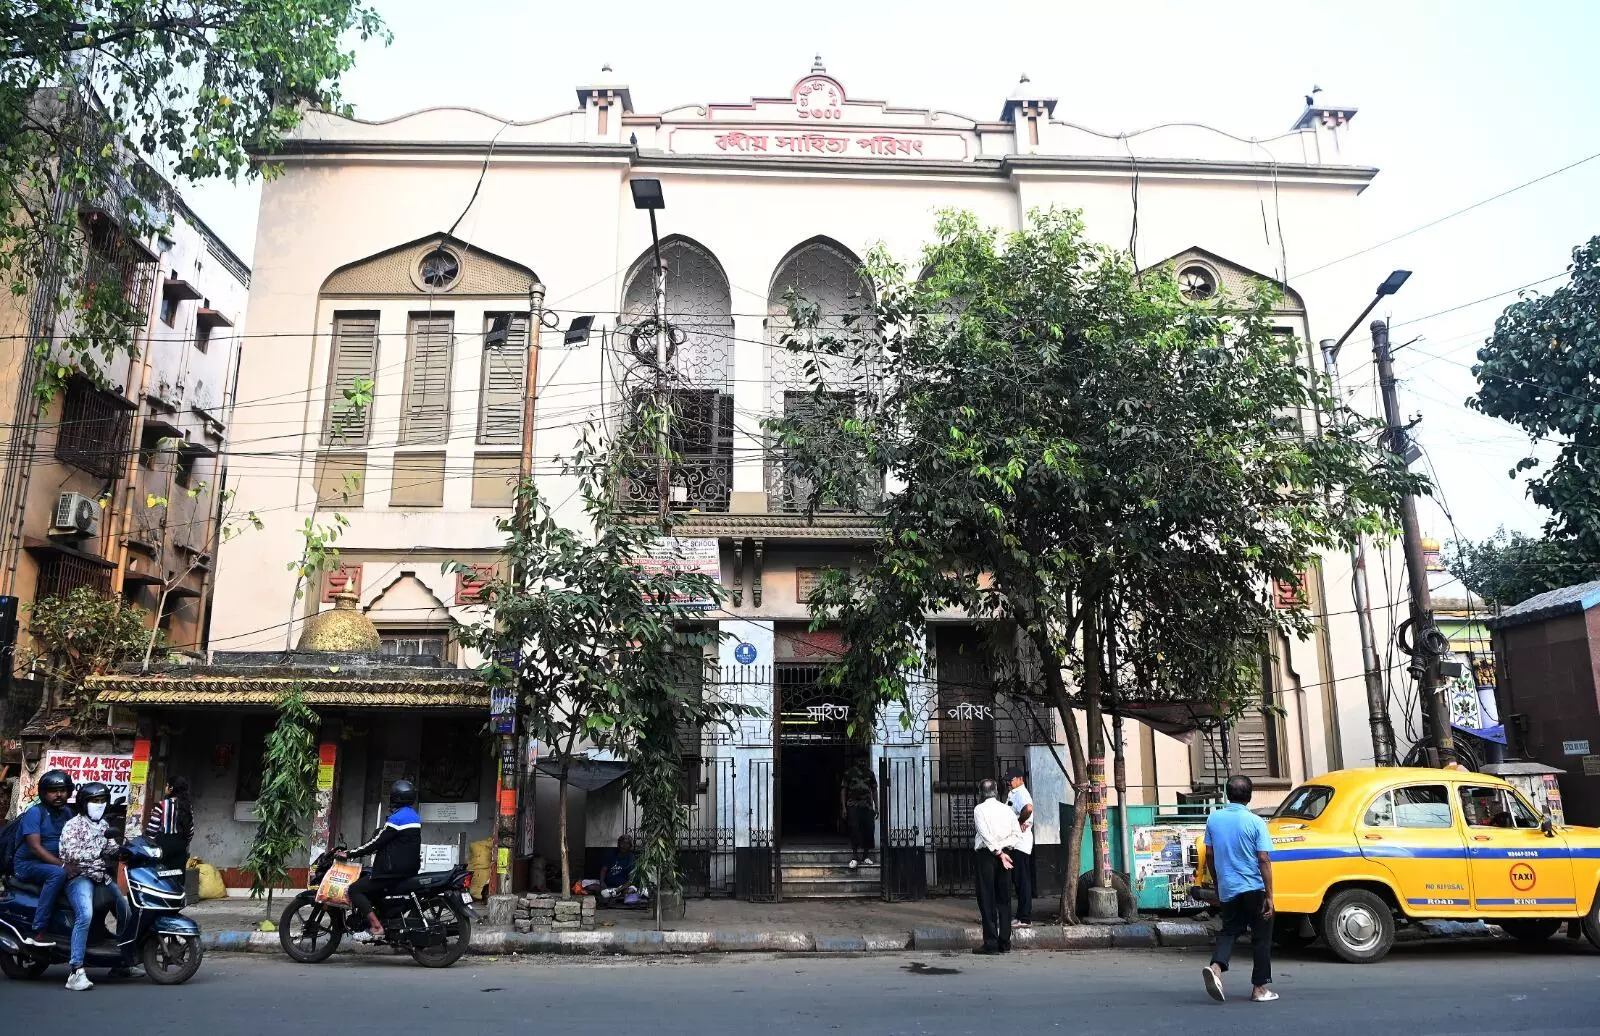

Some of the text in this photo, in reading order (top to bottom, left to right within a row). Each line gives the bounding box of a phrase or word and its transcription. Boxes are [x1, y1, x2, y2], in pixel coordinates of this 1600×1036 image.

[714, 132, 924, 156] বঙ্গীয় সাহিত্য পরিষৎ
[806, 702, 994, 721] সাহিত্য পরিষৎ
[49, 756, 133, 771] এখানে A4 প্যাকে
[1512, 873, 1533, 881] TAXI
